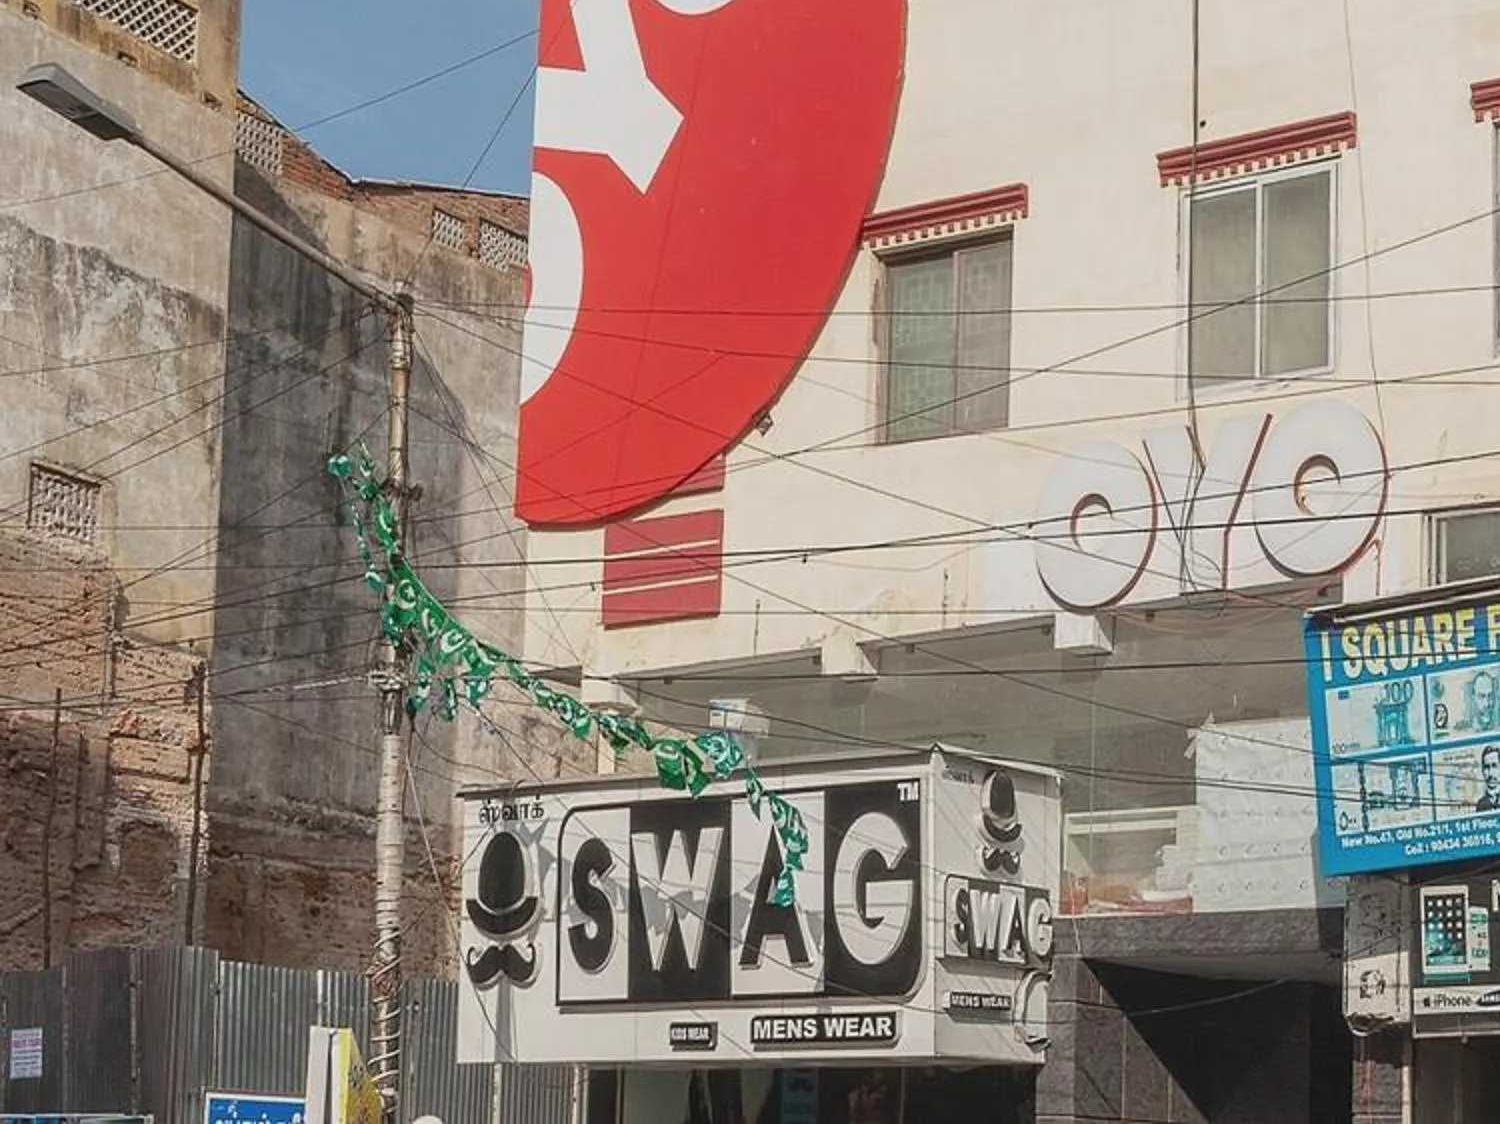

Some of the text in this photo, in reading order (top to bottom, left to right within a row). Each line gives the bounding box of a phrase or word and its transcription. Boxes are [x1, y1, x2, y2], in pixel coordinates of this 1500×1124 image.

[1321, 631, 1333, 682] I
[1342, 608, 1477, 680] SQUARE
[897, 782, 920, 802] TM
[567, 808, 915, 974] SWAG
[953, 887, 1054, 958] SWAG
[1433, 993, 1471, 1008] iPhone
[753, 1016, 893, 1040] MENS WEAR
